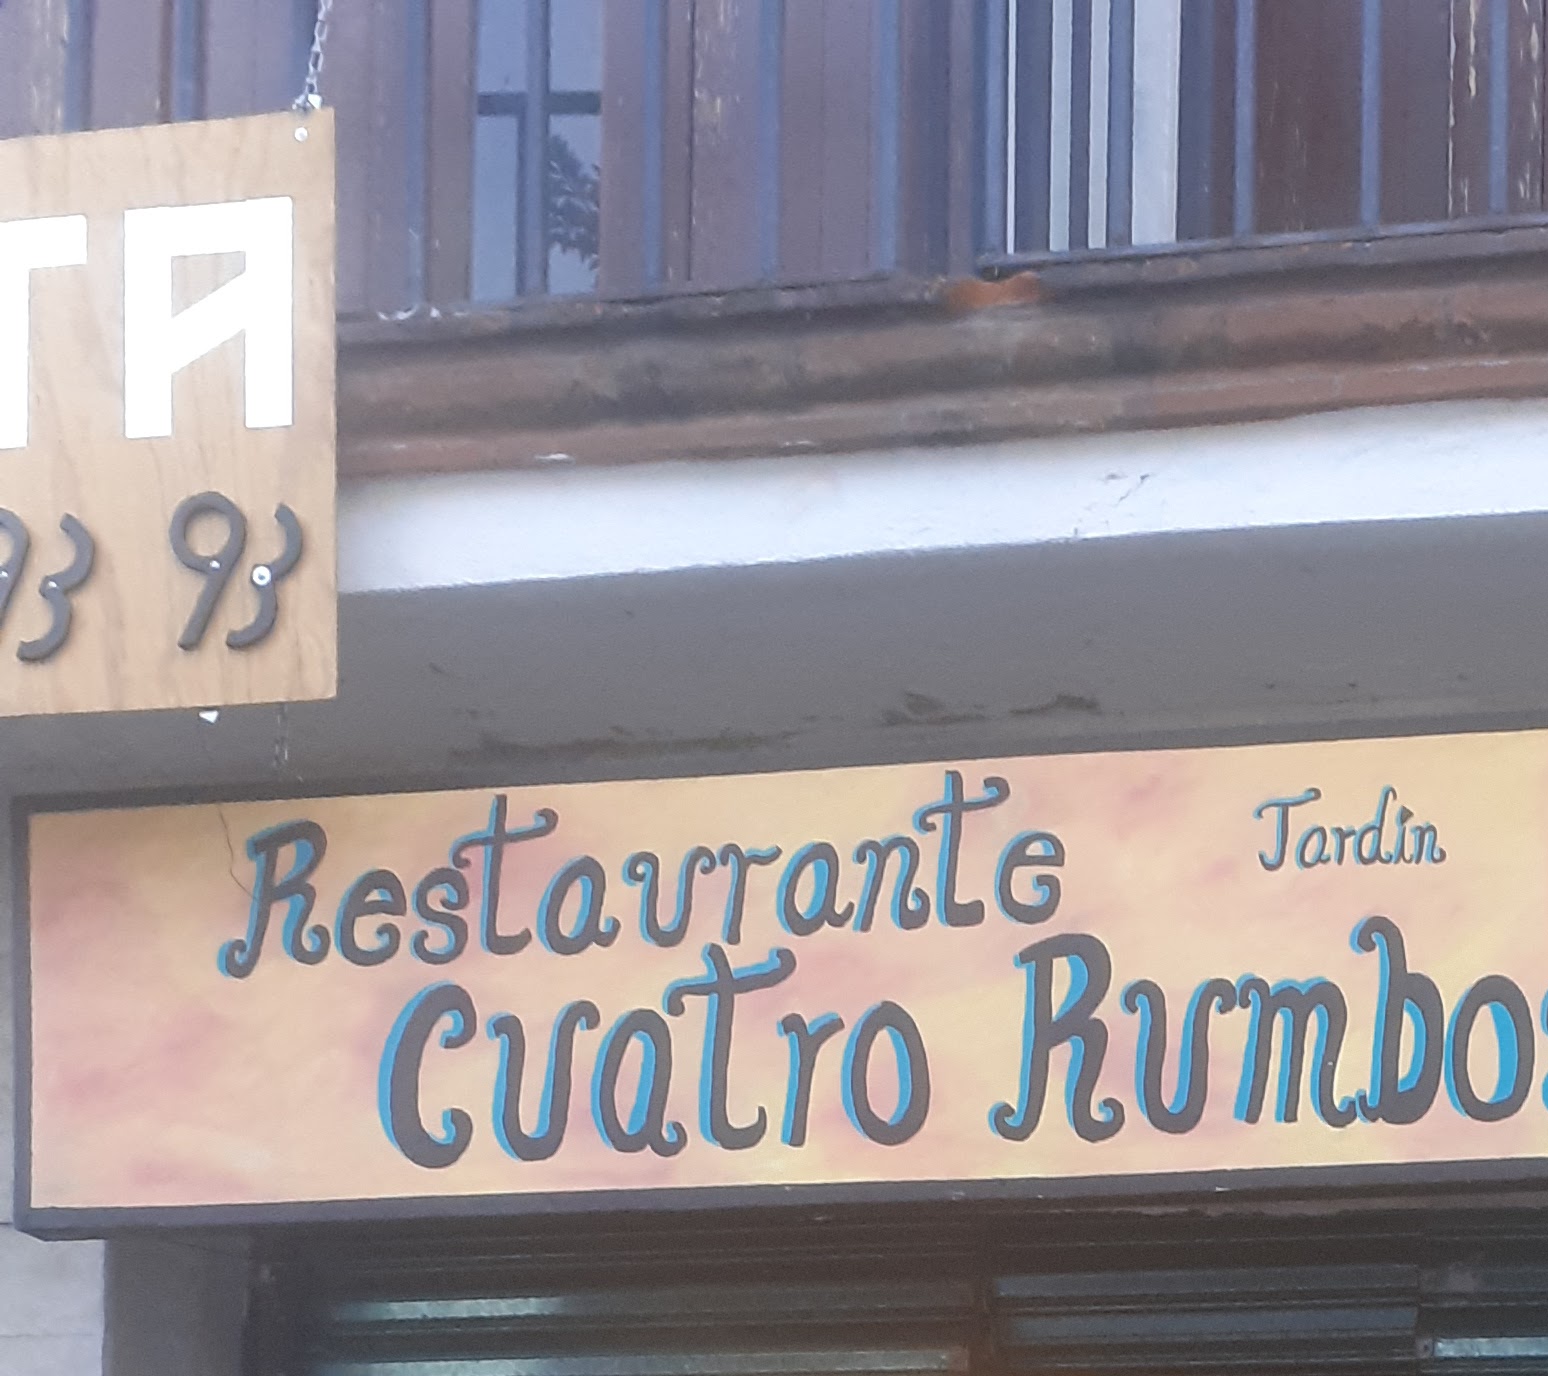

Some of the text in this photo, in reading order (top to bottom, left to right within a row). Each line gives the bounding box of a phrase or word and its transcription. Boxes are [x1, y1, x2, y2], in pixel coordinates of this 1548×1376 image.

[168, 490, 304, 651] 93
[216, 770, 1066, 979] Restaurante
[378, 943, 931, 1169] Cuatro
